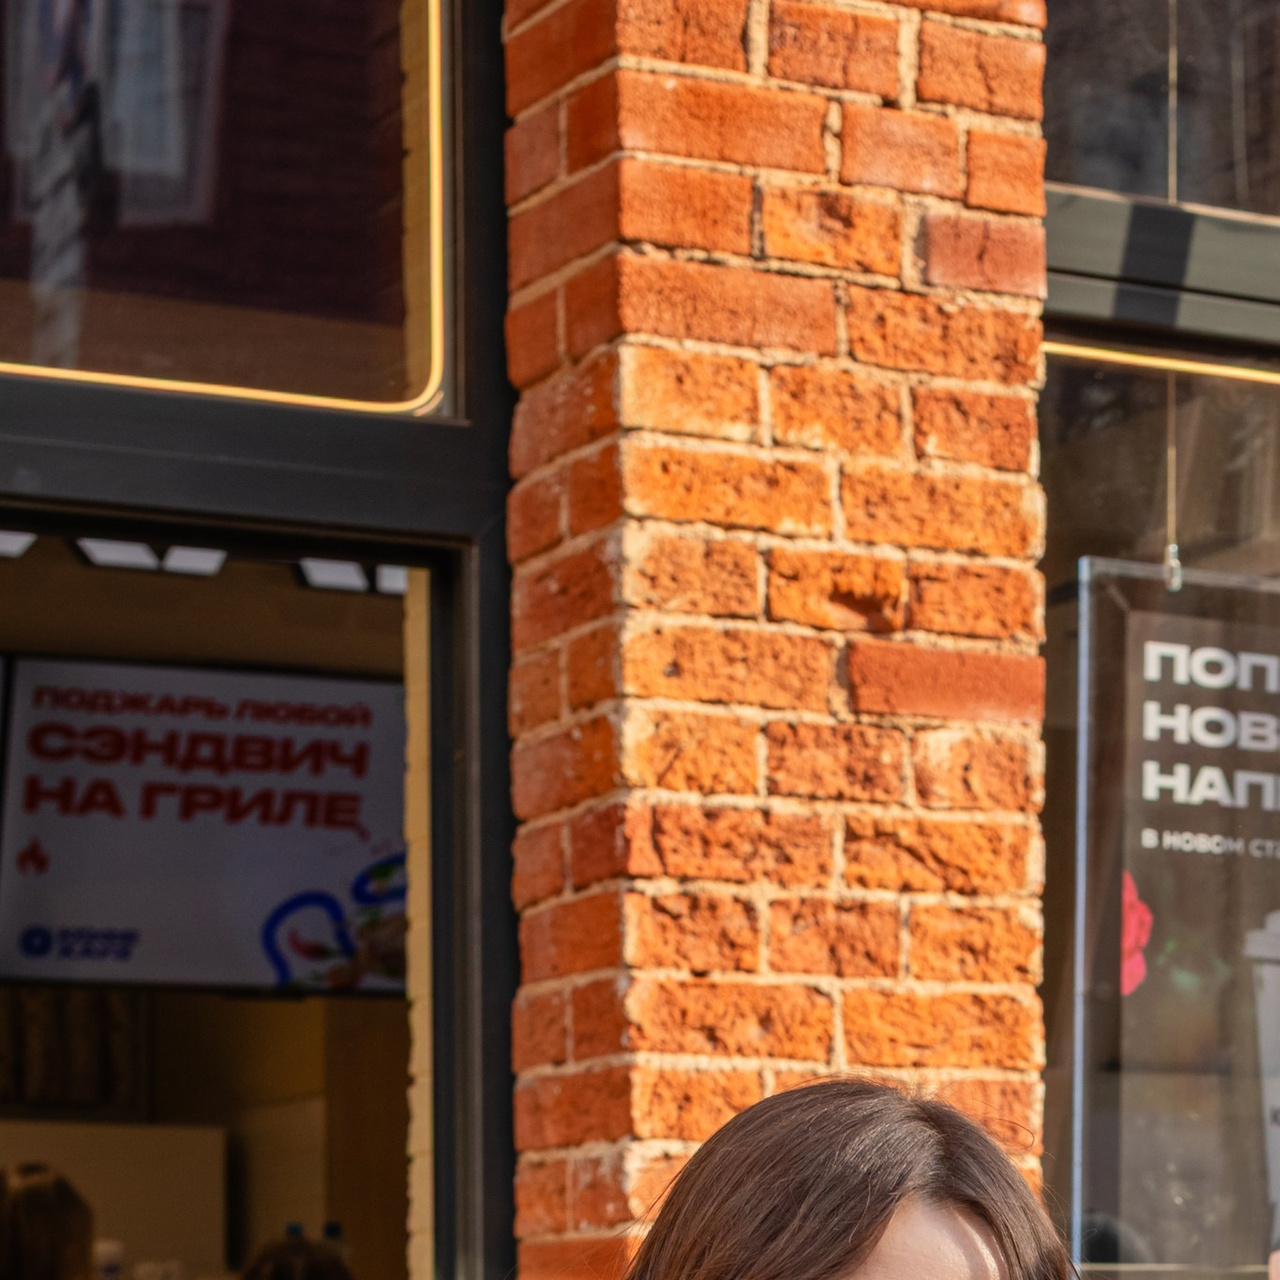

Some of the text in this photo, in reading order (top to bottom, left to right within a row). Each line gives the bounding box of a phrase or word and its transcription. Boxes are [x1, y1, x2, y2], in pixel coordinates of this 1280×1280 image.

[32, 685, 374, 728] ПОДЖАРЬ ЛЮБОЙ
[27, 722, 371, 778] СЭНДВИЧ
[22, 774, 364, 832] НА ГРИЛЕ
